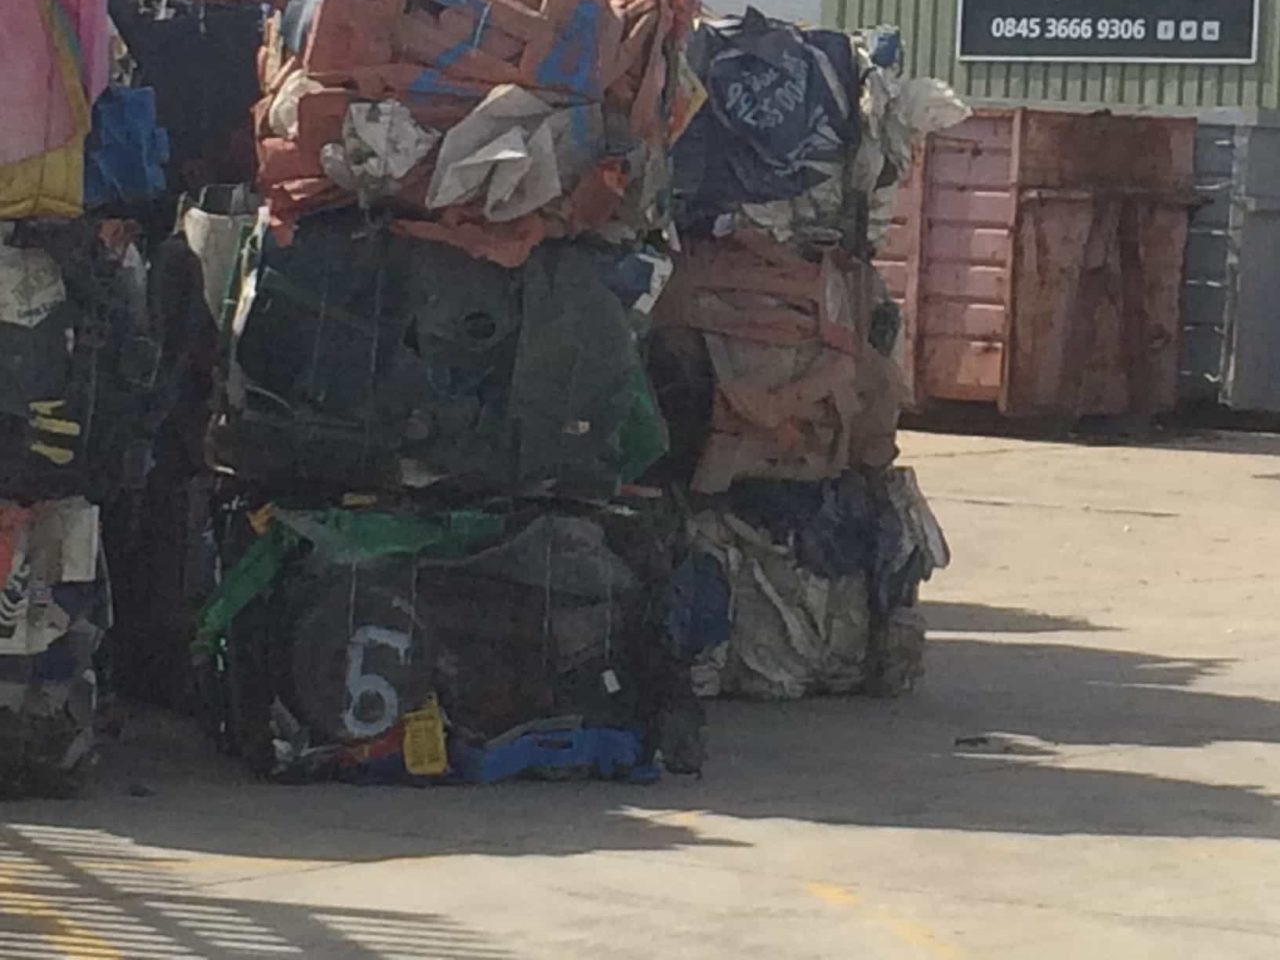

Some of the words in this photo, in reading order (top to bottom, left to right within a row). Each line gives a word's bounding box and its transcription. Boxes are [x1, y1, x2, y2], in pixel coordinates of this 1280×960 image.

[991, 18, 1041, 38] 0845
[1045, 18, 1092, 39] 3666
[1097, 19, 1146, 39] 9306
